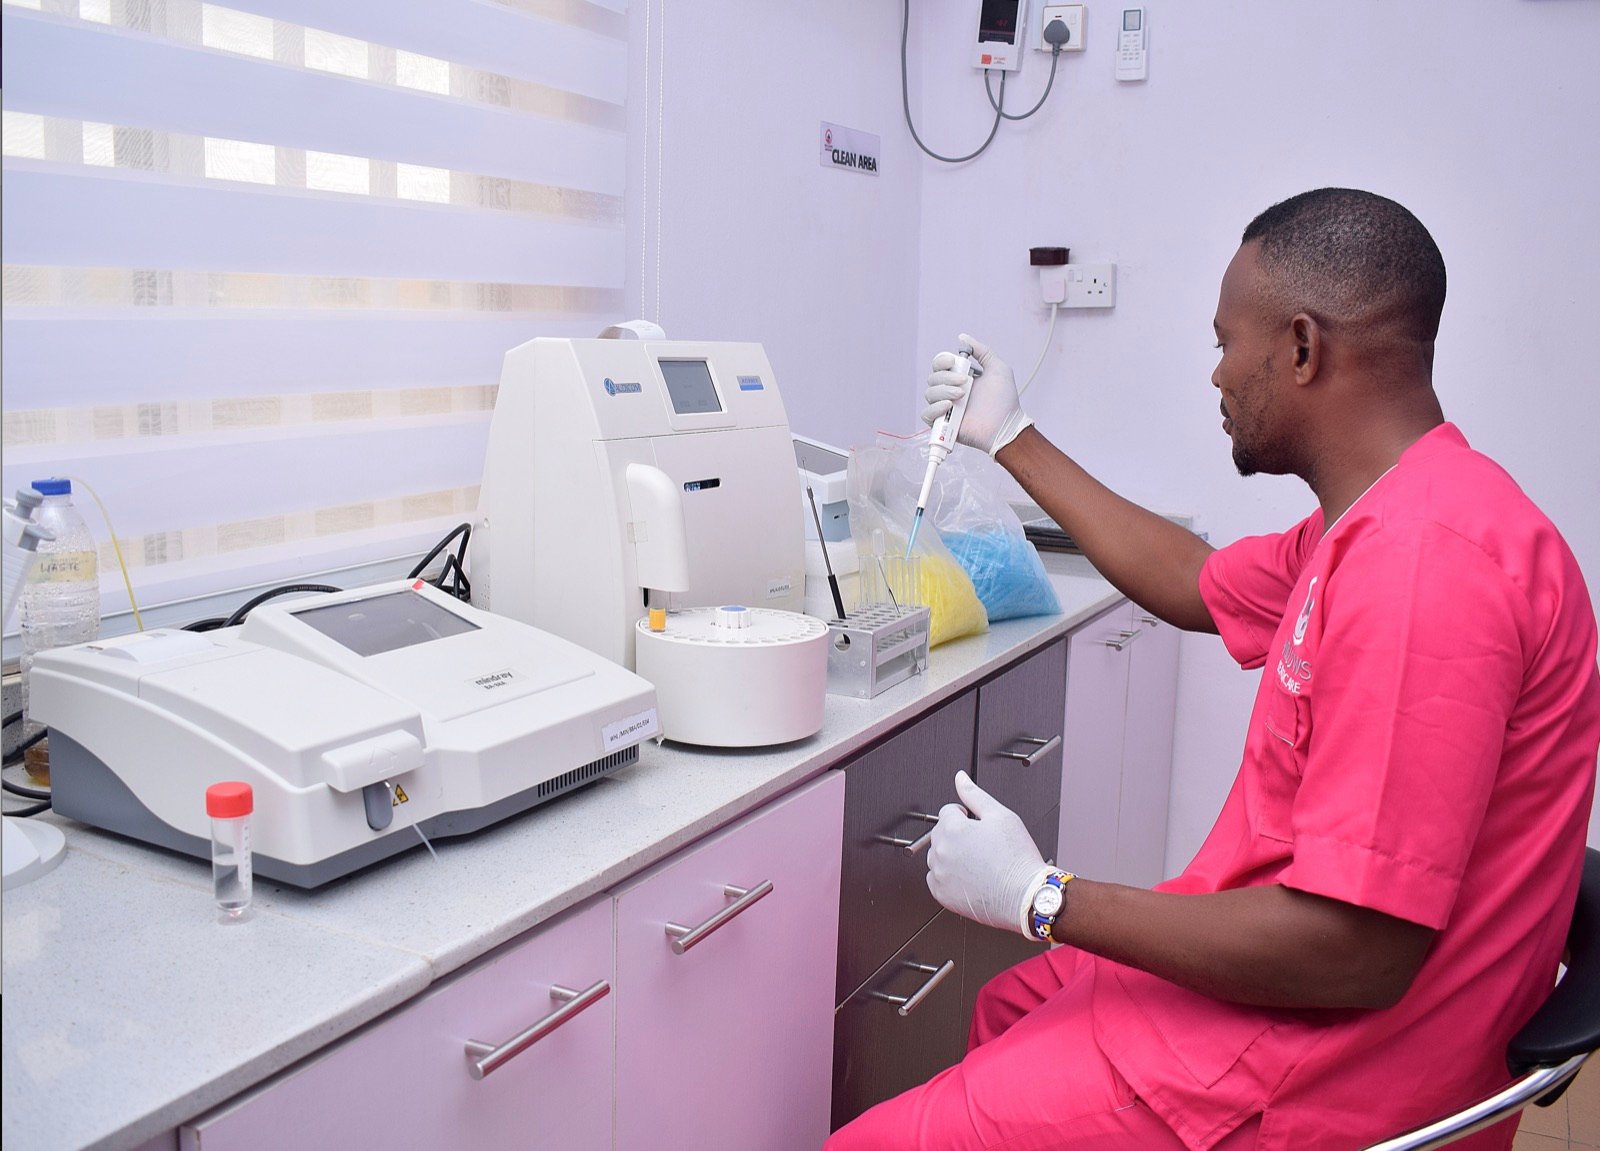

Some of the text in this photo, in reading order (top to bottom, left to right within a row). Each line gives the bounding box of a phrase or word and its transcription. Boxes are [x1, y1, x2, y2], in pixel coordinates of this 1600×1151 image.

[832, 149, 878, 172] CLEAN AREA
[40, 562, 81, 574] WASTE
[475, 671, 514, 686] mindray
